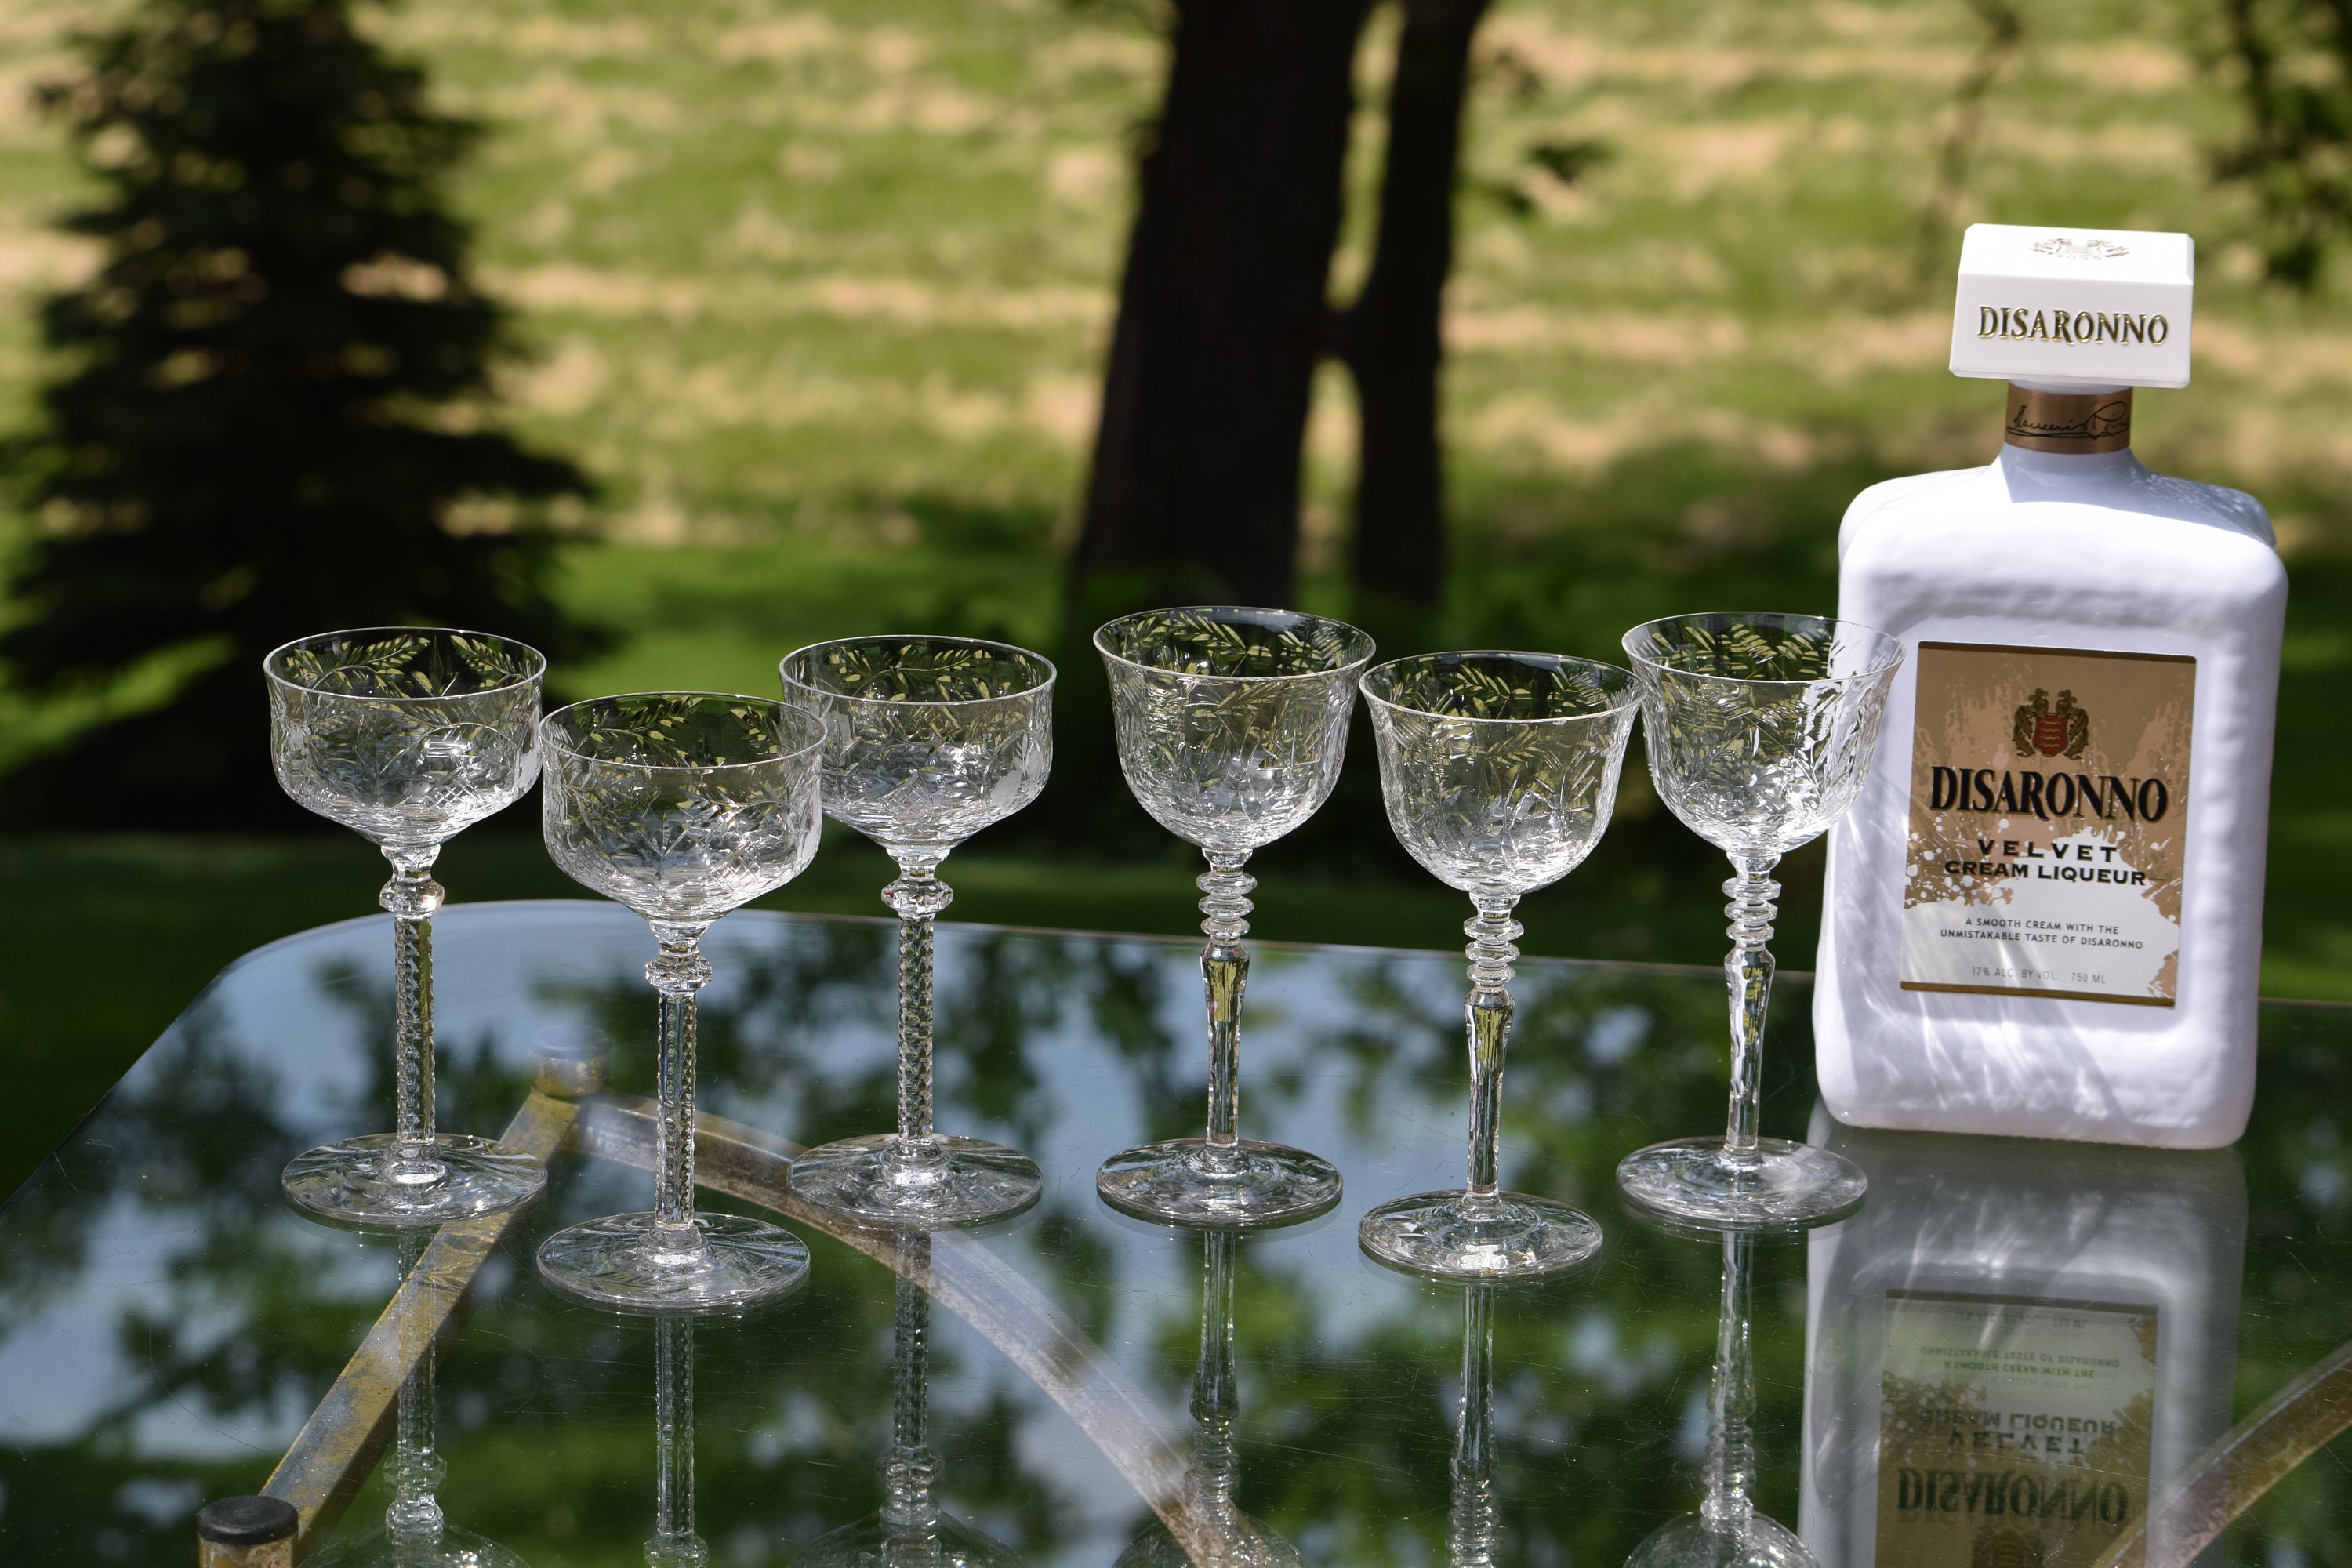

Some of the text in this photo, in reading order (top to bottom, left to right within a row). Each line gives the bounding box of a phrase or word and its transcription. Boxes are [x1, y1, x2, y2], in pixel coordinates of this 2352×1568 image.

[1978, 306, 2169, 346] DISARONNO
[1929, 765, 2169, 822] DISARONNO
[1977, 839, 2118, 863] VELVET
[1944, 861, 2146, 886] CREAM LIQUEUR
[1965, 917, 2119, 935] A SMOOTH CREAM WITH THE
[1940, 928, 2143, 949] UNMISTAKABLE TASTE OF DISARONNO
[1972, 966, 1991, 977] 17%
[2021, 969, 2034, 979] BY
[2071, 972, 2089, 983] 750
[2092, 975, 2107, 985] ML
